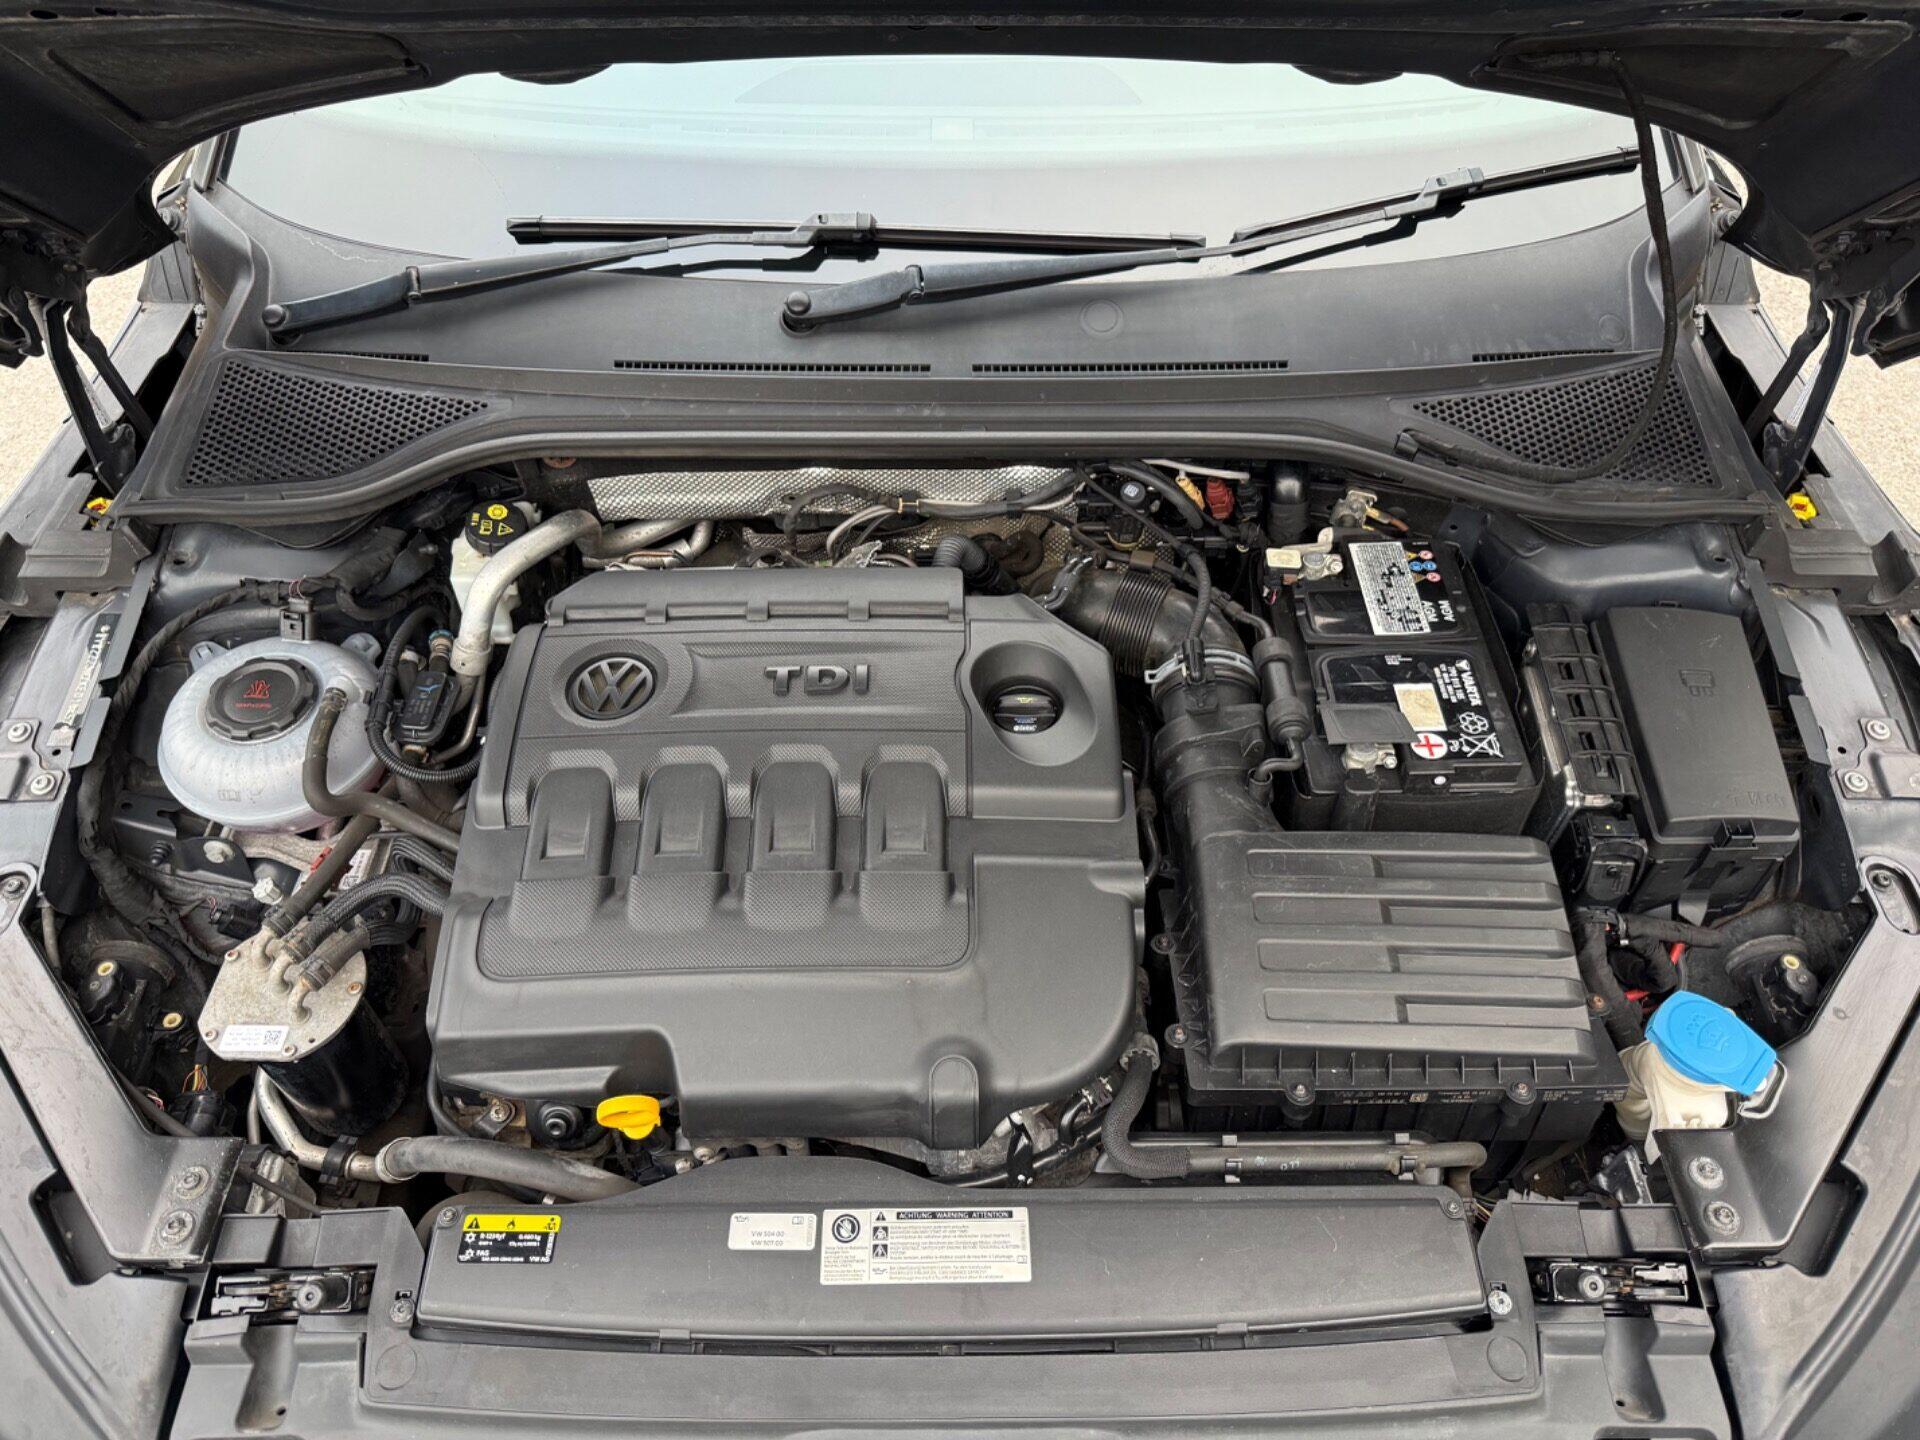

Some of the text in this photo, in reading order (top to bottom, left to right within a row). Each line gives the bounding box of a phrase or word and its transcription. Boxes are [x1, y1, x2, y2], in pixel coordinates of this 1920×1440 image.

[1421, 600, 1439, 622] AGM
[1438, 600, 1456, 622] AGM
[763, 663, 871, 697] TDI
[1460, 670, 1482, 706] VARTA
[1448, 740, 1460, 752] Pb
[898, 1210, 1009, 1219] ACHTUNG WARNING ATTENTION
